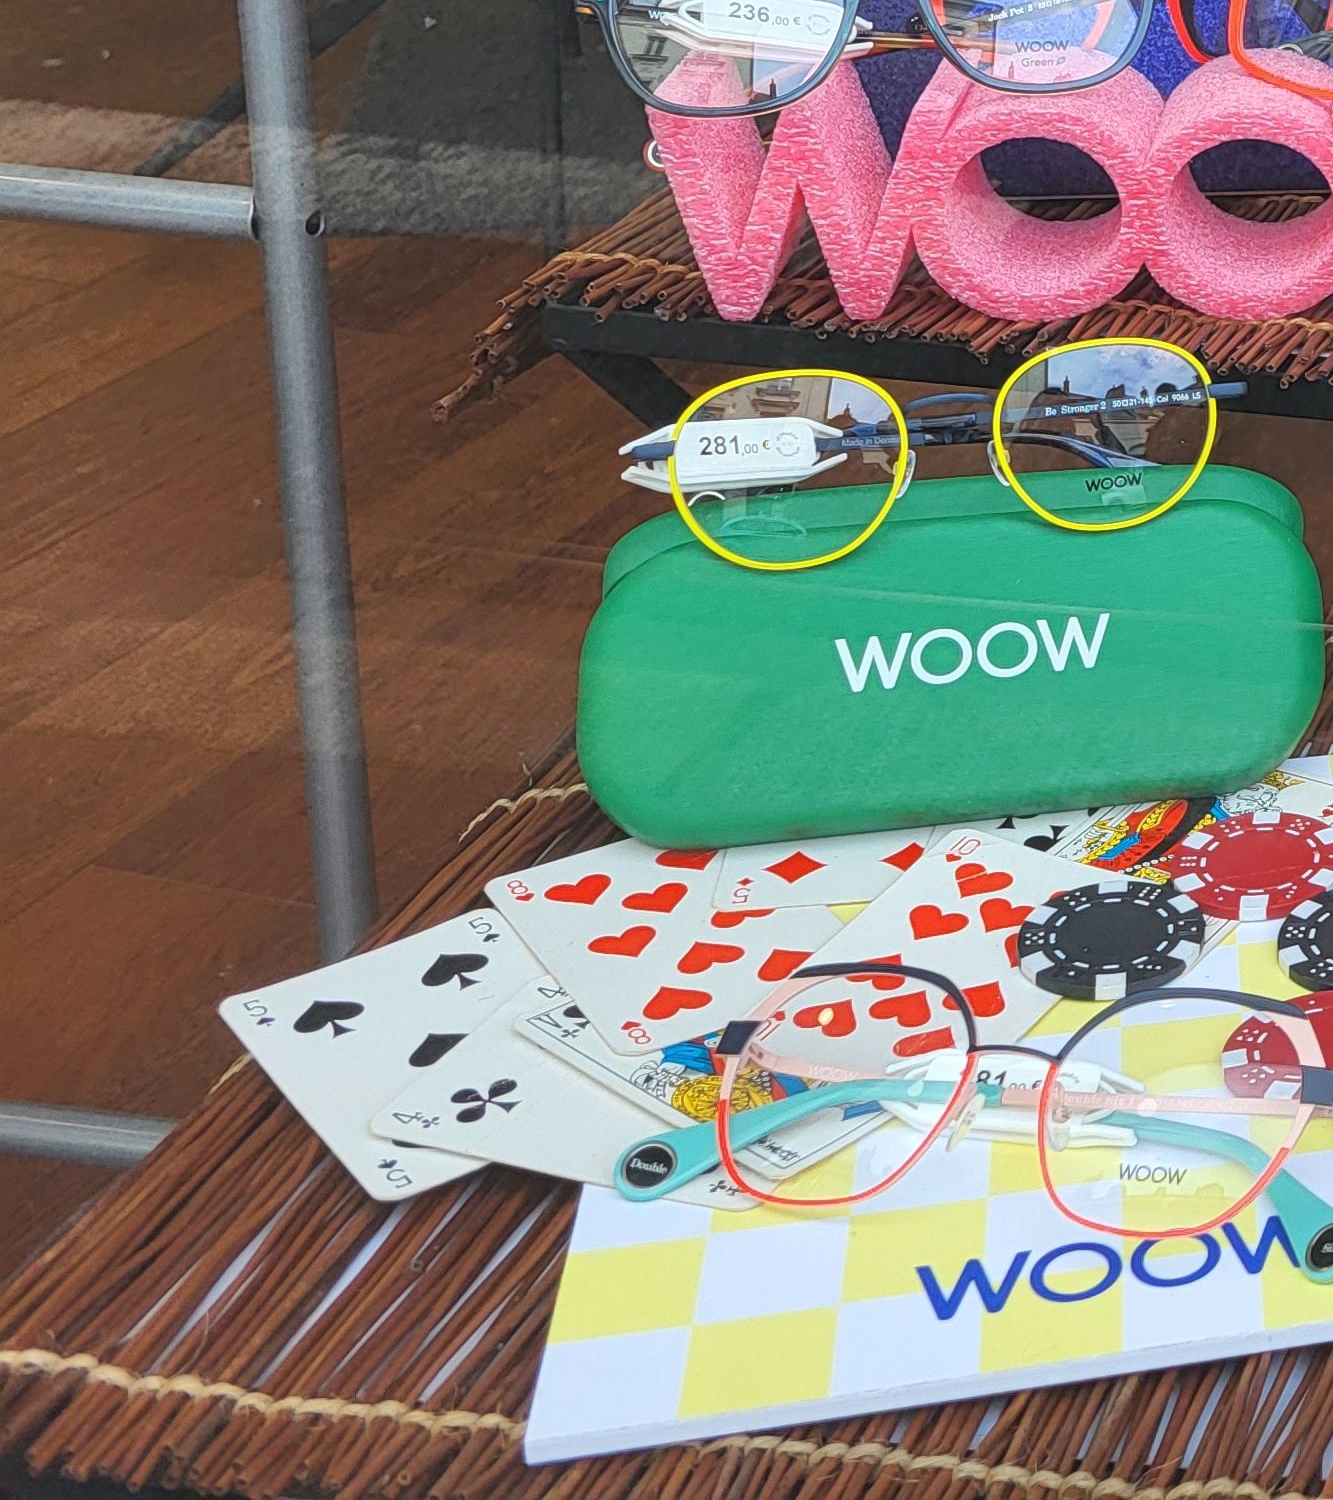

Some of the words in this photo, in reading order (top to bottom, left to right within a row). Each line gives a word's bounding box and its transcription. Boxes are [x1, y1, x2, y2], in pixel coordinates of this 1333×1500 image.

[727, 1, 790, 27] 236,00
[792, 16, 802, 26] €
[988, 11, 1009, 23] Jack
[1009, 7, 1025, 18] Pot
[1014, 40, 1070, 53] WOOW
[1020, 57, 1054, 68] Green
[1045, 406, 1058, 417] Be
[1060, 403, 1099, 416] Stronger
[1156, 394, 1169, 403] Col
[699, 435, 759, 457] 281,00
[841, 437, 864, 448] Made
[1085, 472, 1143, 493] WOOW
[834, 612, 1111, 693] WOOW
[629, 1157, 668, 1175] Double
[1119, 1162, 1188, 1186] WOOW
[916, 1215, 1301, 1321] WOOW
